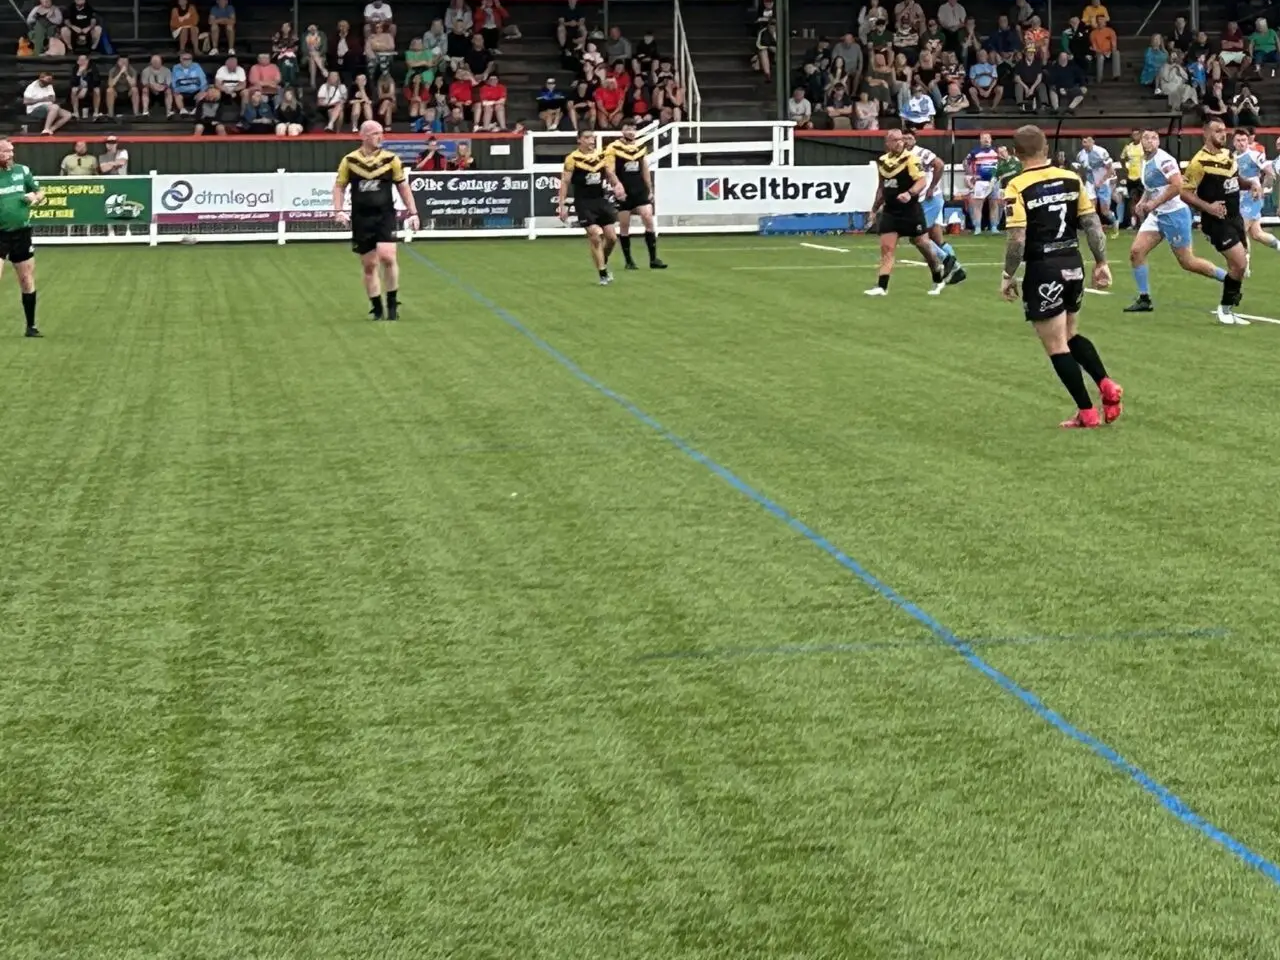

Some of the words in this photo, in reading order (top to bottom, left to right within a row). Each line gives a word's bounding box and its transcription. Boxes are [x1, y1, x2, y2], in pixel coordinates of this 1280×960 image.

[447, 178, 499, 193] Cottage
[501, 176, 529, 190] Inn
[723, 176, 851, 204] keltbray
[194, 189, 274, 208] dtmlegal
[1048, 203, 1067, 240] 7
